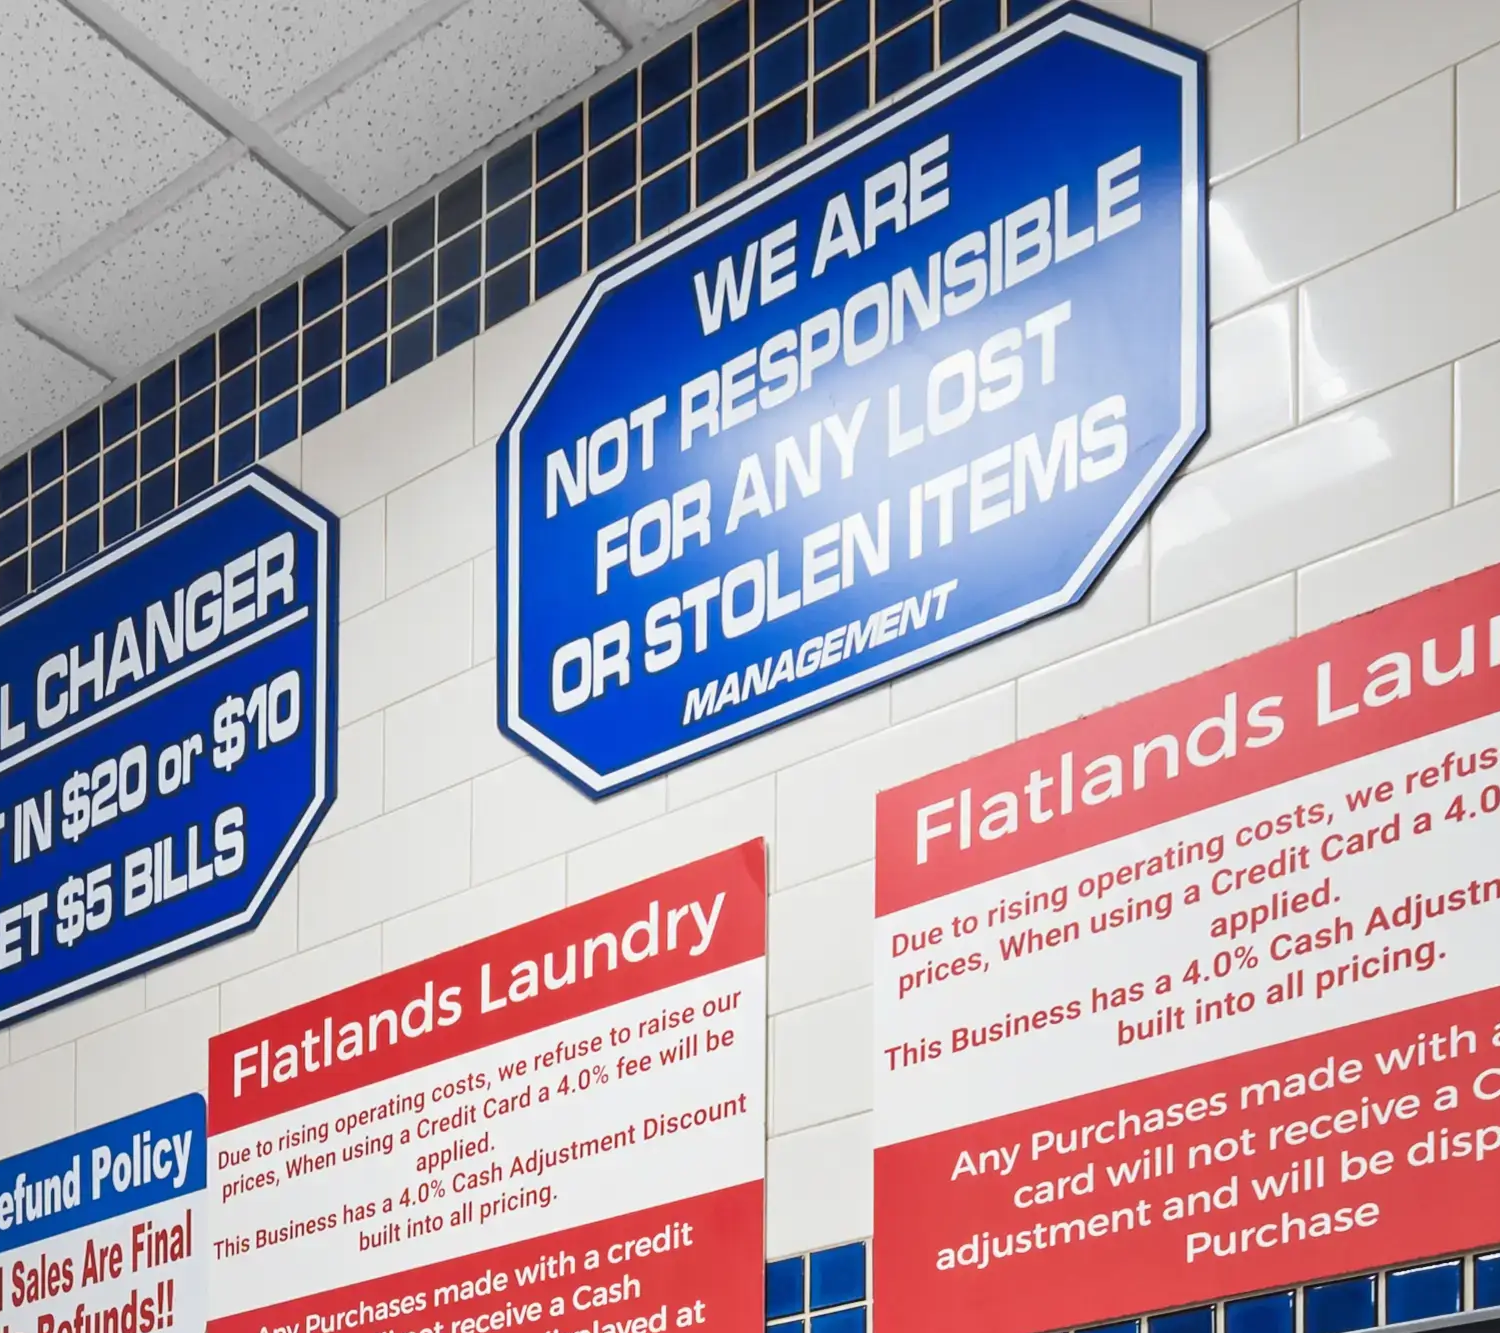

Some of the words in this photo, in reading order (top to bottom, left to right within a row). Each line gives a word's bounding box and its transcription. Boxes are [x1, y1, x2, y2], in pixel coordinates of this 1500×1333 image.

[692, 219, 798, 336] WE
[811, 133, 950, 279] ARE
[546, 396, 667, 519] NOT
[679, 145, 1142, 451] RESPONSIBLE
[596, 478, 711, 594] FOR
[724, 401, 869, 535] ANY
[887, 300, 1072, 461] LOST
[36, 531, 295, 730] CHANGER
[551, 600, 631, 714] OR
[644, 497, 891, 675] STOLEN
[909, 394, 1128, 559] ITEMS
[682, 579, 958, 726] MANAGEMENT
[13, 789, 52, 863] IN
[62, 744, 147, 842] $20
[158, 733, 203, 795] or
[212, 670, 300, 771] $10
[915, 692, 1285, 866] Flatlands
[55, 863, 112, 946] $5
[124, 806, 244, 916] BILLS
[217, 1147, 251, 1171] Due
[256, 1141, 273, 1158] to
[279, 1122, 329, 1151] rising
[334, 1092, 426, 1135] operating
[430, 1067, 491, 1107] costs,
[498, 1060, 527, 1082] we
[534, 1036, 602, 1071] refuse
[610, 1027, 631, 1047] to
[638, 1006, 695, 1039] raise
[702, 990, 742, 1018] our
[233, 981, 462, 1098] Flatlands
[481, 892, 726, 1014] Laundry
[92, 1130, 192, 1189] Policy
[12, 1253, 73, 1307] Sales
[81, 1238, 123, 1288] Are
[132, 1208, 192, 1273] Final
